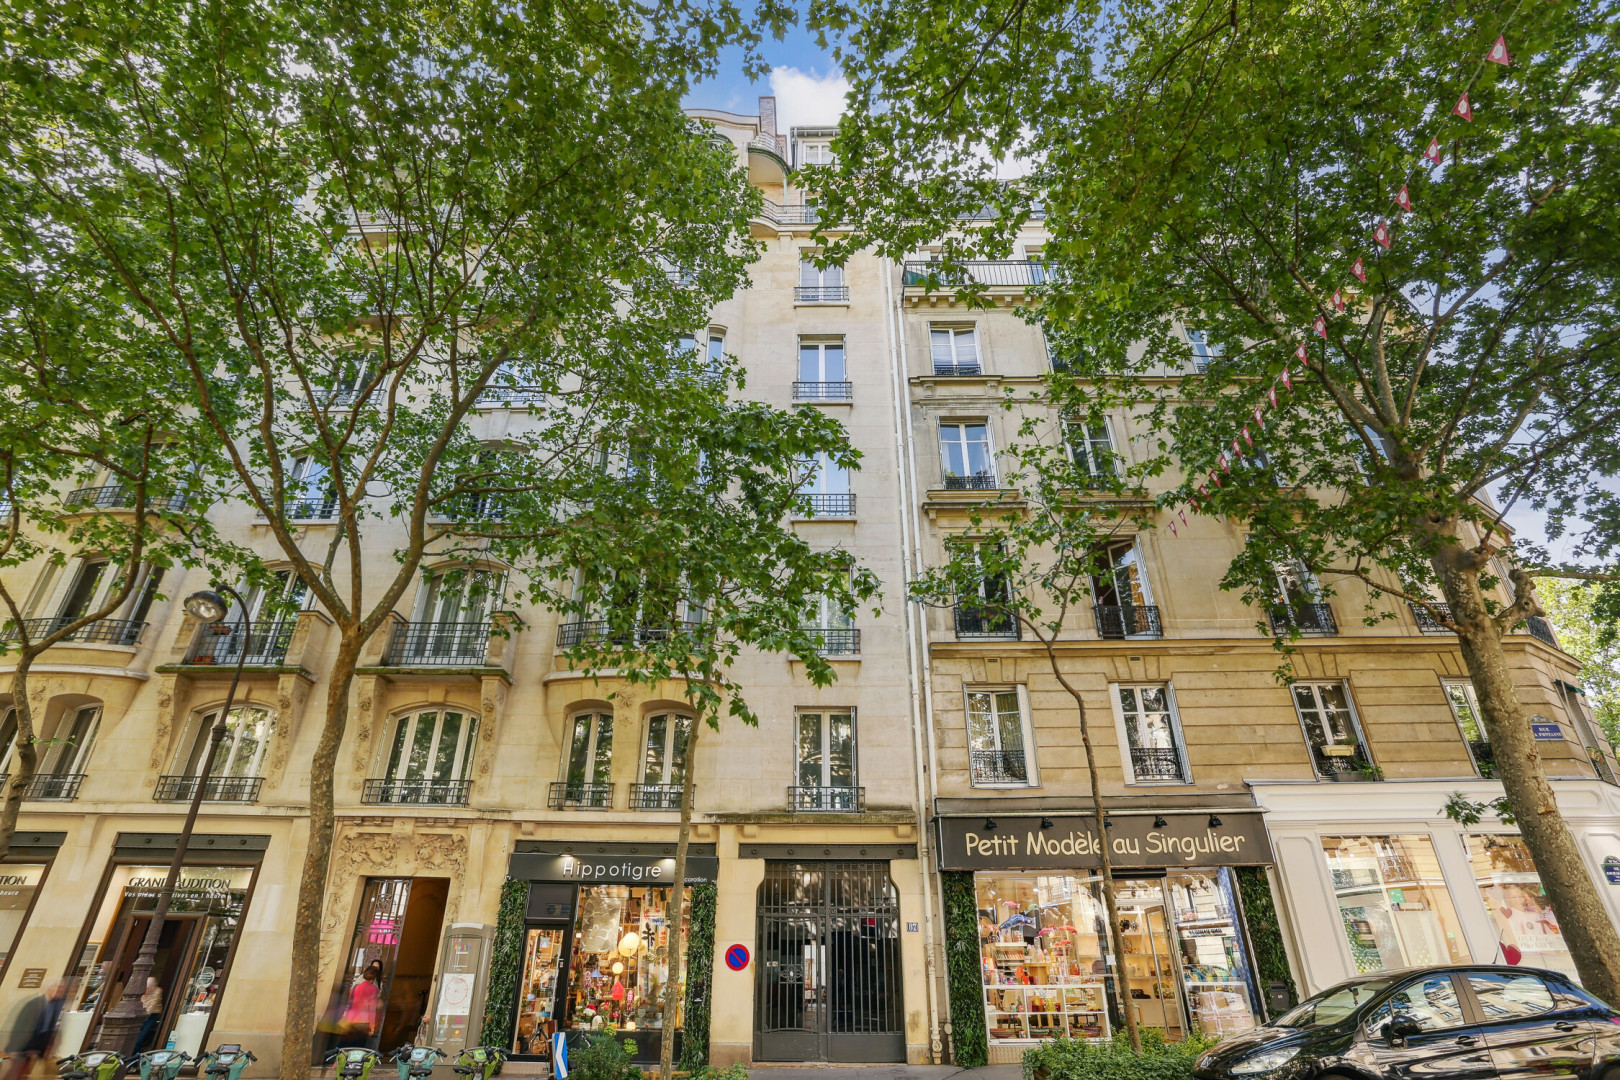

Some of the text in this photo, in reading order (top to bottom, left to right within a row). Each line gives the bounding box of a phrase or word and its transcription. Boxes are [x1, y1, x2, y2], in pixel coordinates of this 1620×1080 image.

[965, 828, 1246, 861] Petit Modèle au Singulier
[563, 861, 662, 880] Hippotigre
